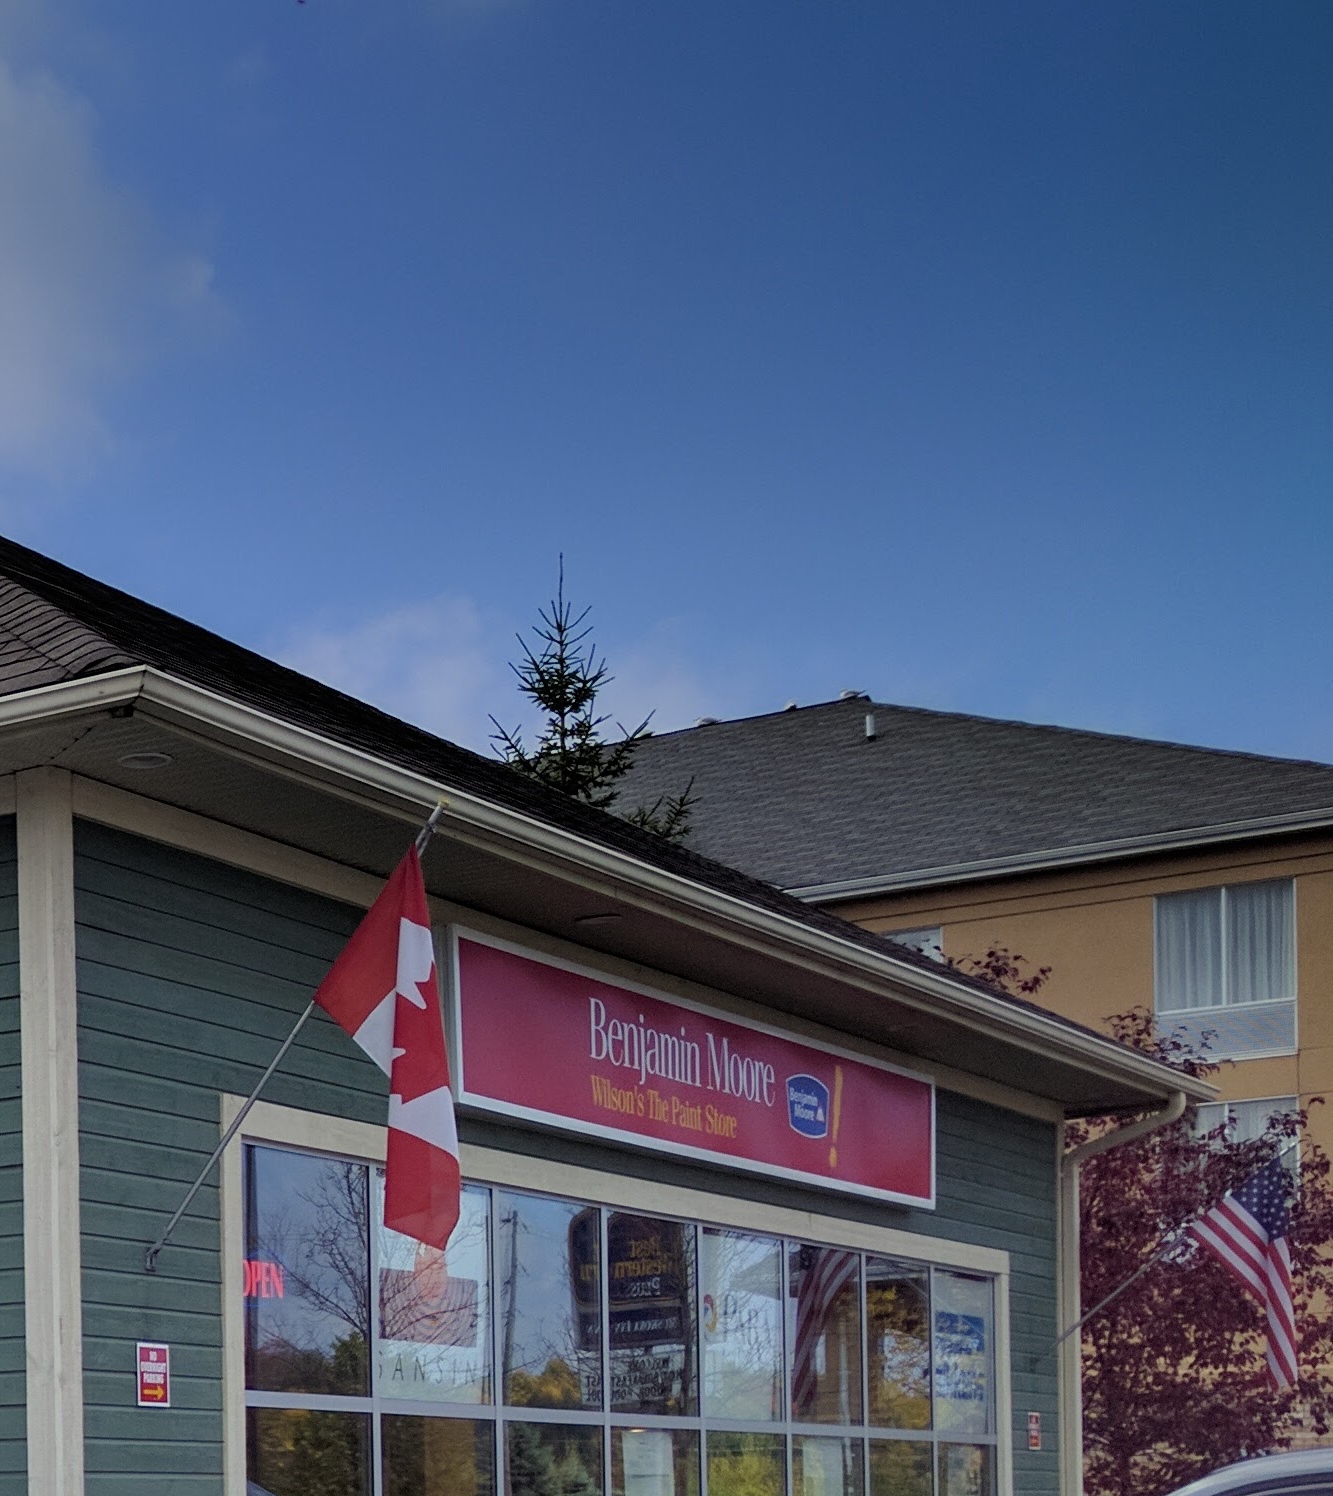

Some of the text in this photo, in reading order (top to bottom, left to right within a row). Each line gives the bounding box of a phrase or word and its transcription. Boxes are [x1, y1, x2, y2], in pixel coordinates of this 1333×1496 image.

[589, 997, 776, 1107] Benjamin Moore
[591, 1073, 737, 1139] Wilson's The Paint Store
[790, 1087, 818, 1106] Benjamin
[794, 1103, 815, 1121] Moore
